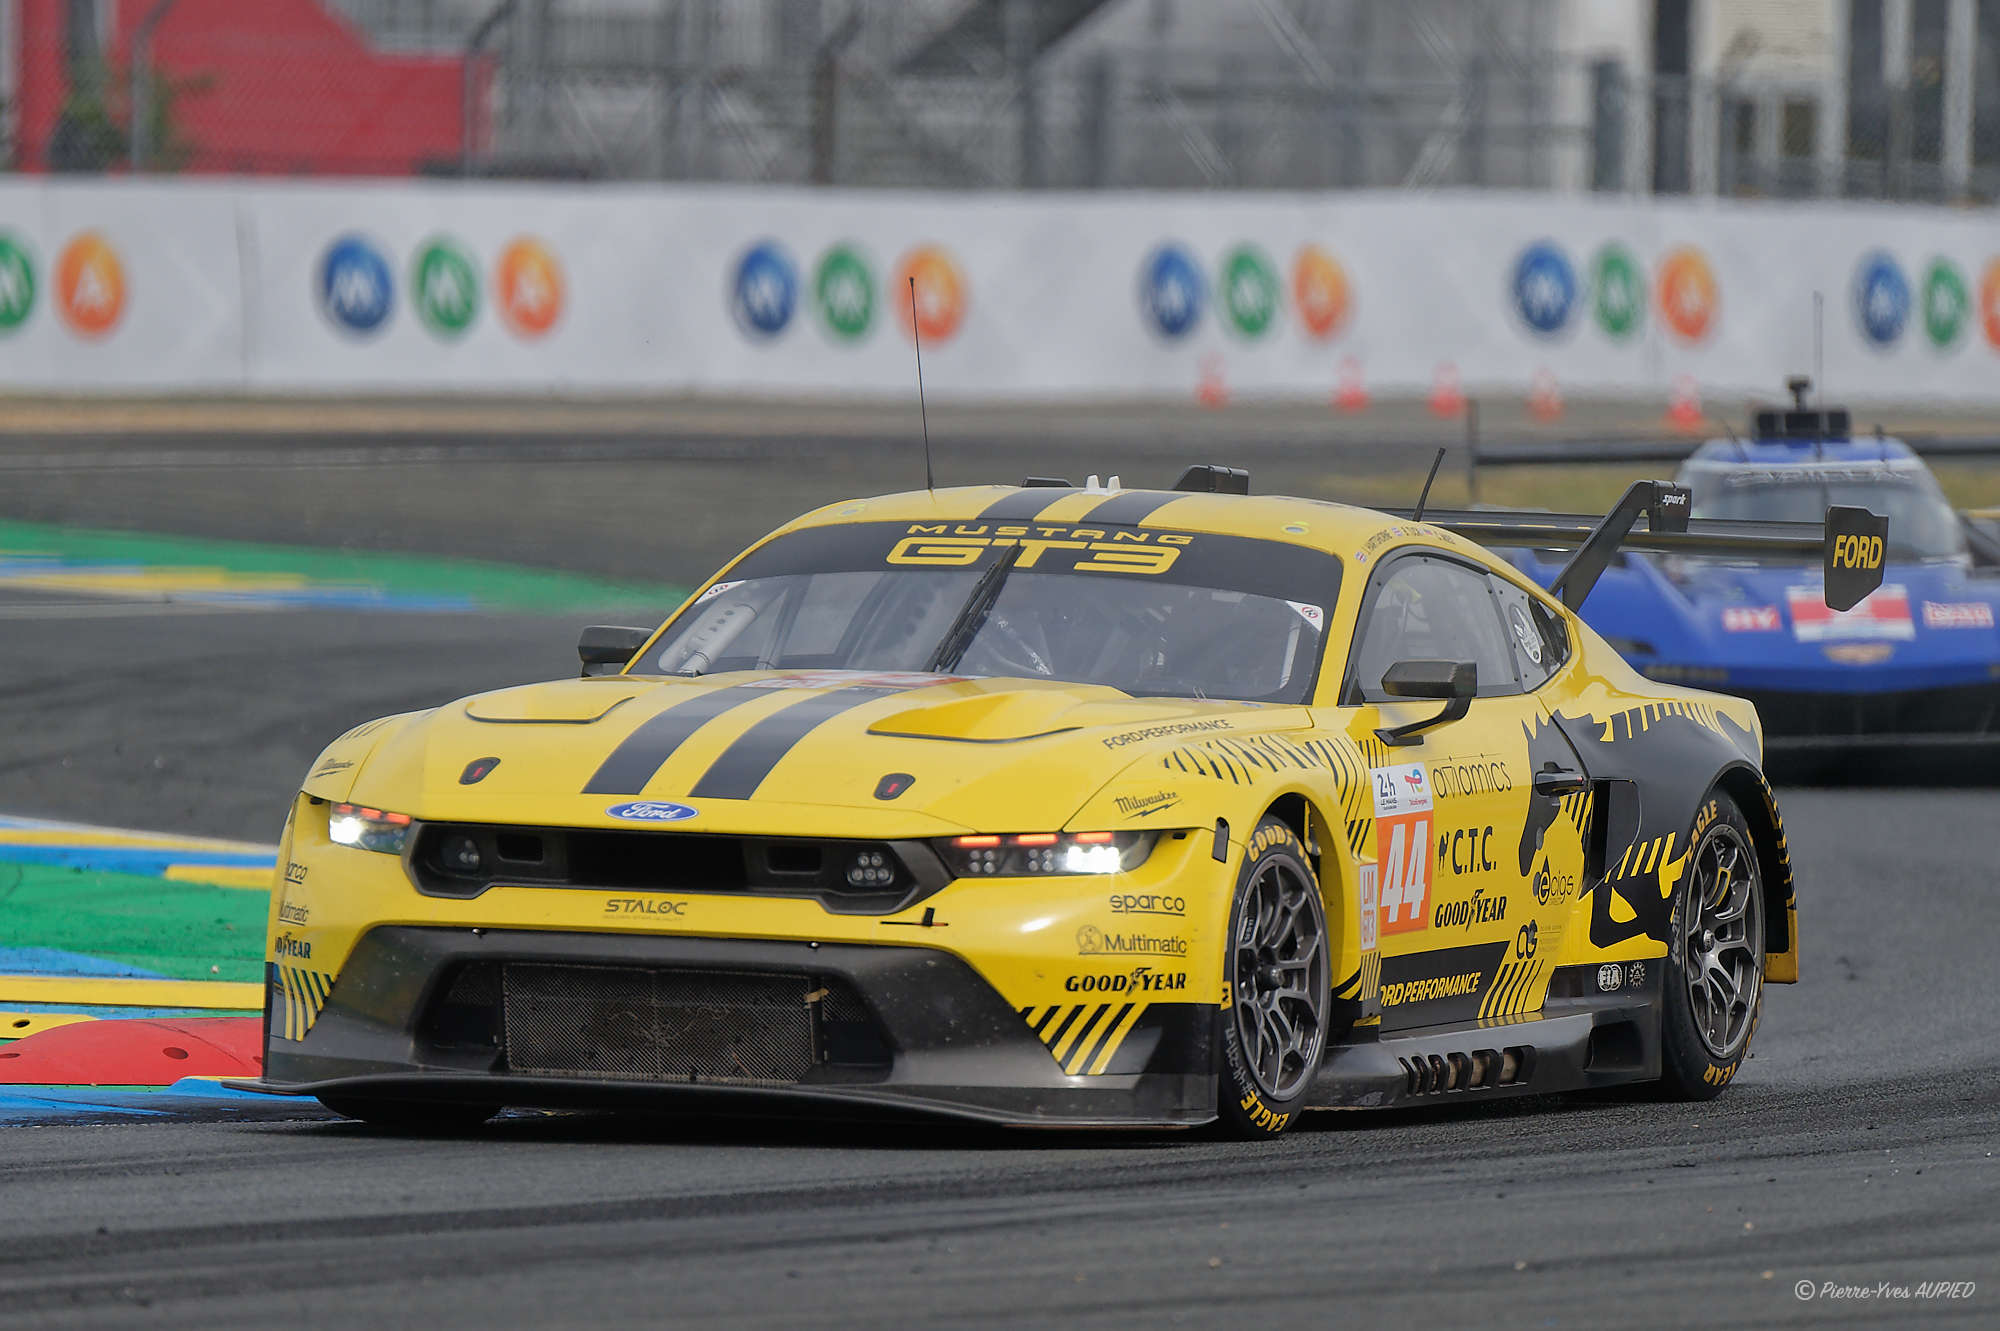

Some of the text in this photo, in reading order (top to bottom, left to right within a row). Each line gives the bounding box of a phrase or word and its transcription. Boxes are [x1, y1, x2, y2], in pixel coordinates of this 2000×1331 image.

[1662, 493, 1687, 506] spark
[906, 524, 1195, 545] MUSTANG
[886, 536, 1182, 575] GT3
[1832, 534, 1883, 569] FORD
[1102, 719, 1235, 750] FORD PERFORMANCE
[621, 802, 682, 820] Ford
[1112, 791, 1180, 815] Milwaukee
[1452, 825, 1497, 875] C.T.C.
[1380, 820, 1428, 923] 44
[604, 898, 689, 916] STALOC
[1109, 894, 1186, 915] sparco
[1103, 932, 1188, 955] Multimatic
[1380, 971, 1482, 1008] ORD PERFORMANCE
[1240, 1089, 1291, 1133] EAGLE
